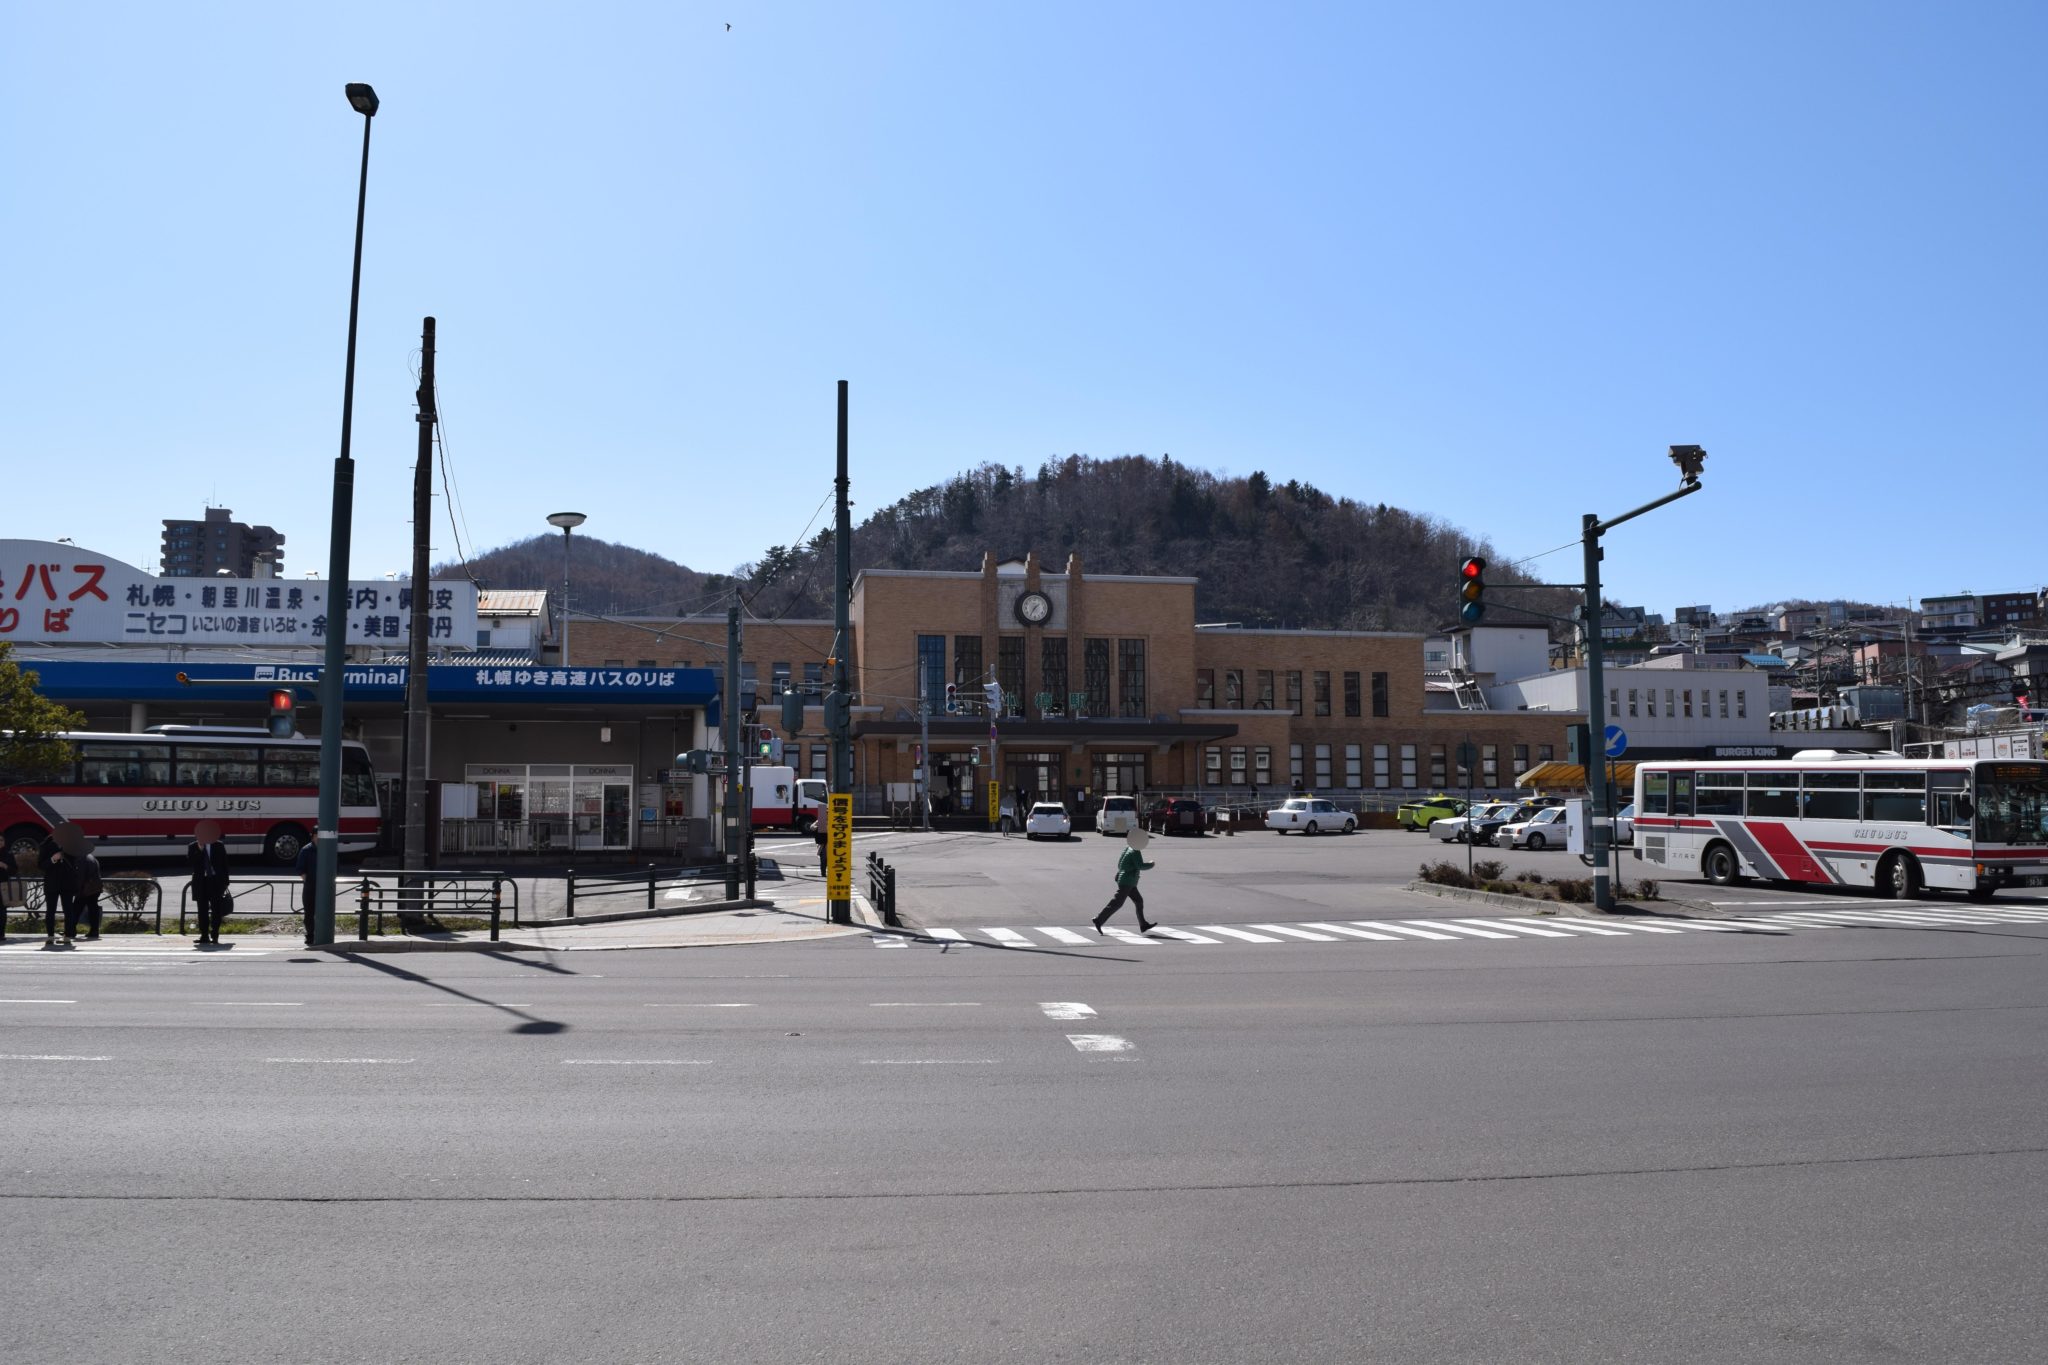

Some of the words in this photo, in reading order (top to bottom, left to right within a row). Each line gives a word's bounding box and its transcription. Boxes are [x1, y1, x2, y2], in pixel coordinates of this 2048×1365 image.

[278, 668, 314, 681] Bus
[476, 669, 675, 687] 札幌ゆき高速バスのりば
[1715, 747, 1753, 757] BURGER
[1754, 747, 1778, 757] KING
[482, 767, 511, 775] DONNA
[588, 767, 617, 775] DONNA
[142, 799, 208, 812] CHUO
[216, 799, 261, 812] BUS
[1854, 829, 1884, 839] CHUO
[1884, 829, 1908, 840] BUS
